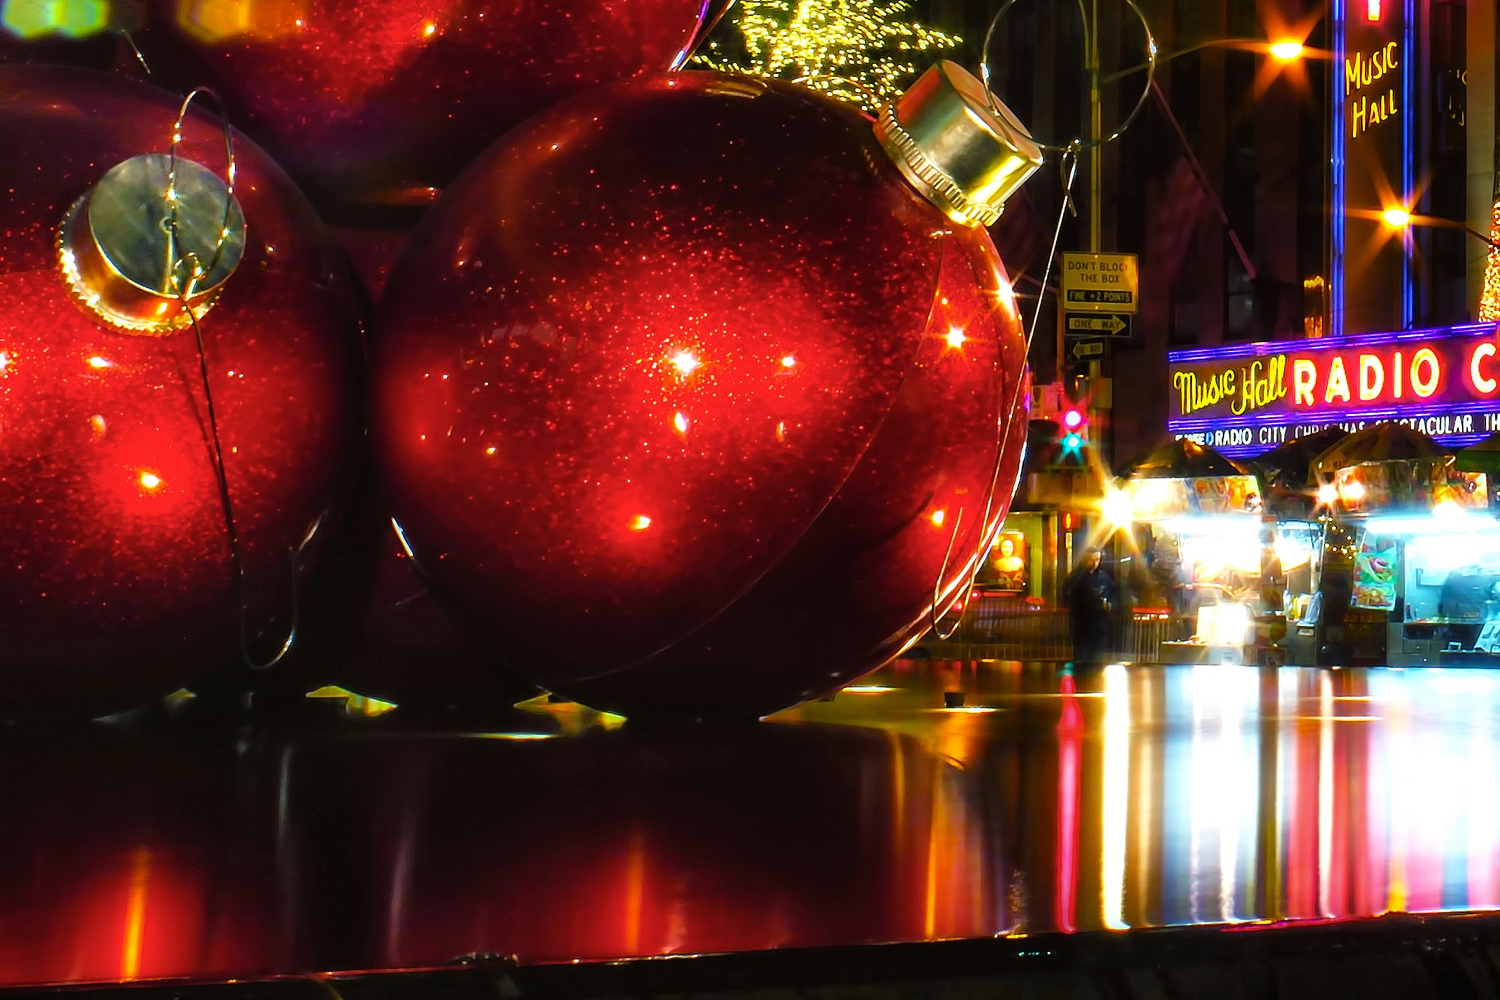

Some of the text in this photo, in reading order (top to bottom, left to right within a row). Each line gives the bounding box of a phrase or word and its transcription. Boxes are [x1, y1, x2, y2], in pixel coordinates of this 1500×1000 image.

[1345, 41, 1398, 96] MUSIC
[1352, 89, 1398, 138] HALL
[1068, 261, 1096, 271] DON'T
[1080, 273, 1120, 283] THE BOX
[1074, 319, 1121, 328] ONE WAY
[1173, 368, 1236, 414] Music
[1231, 354, 1288, 415] Hall
[1294, 347, 1440, 405] RADIO
[1215, 429, 1252, 446] RADIO
[1259, 426, 1287, 444] CITY
